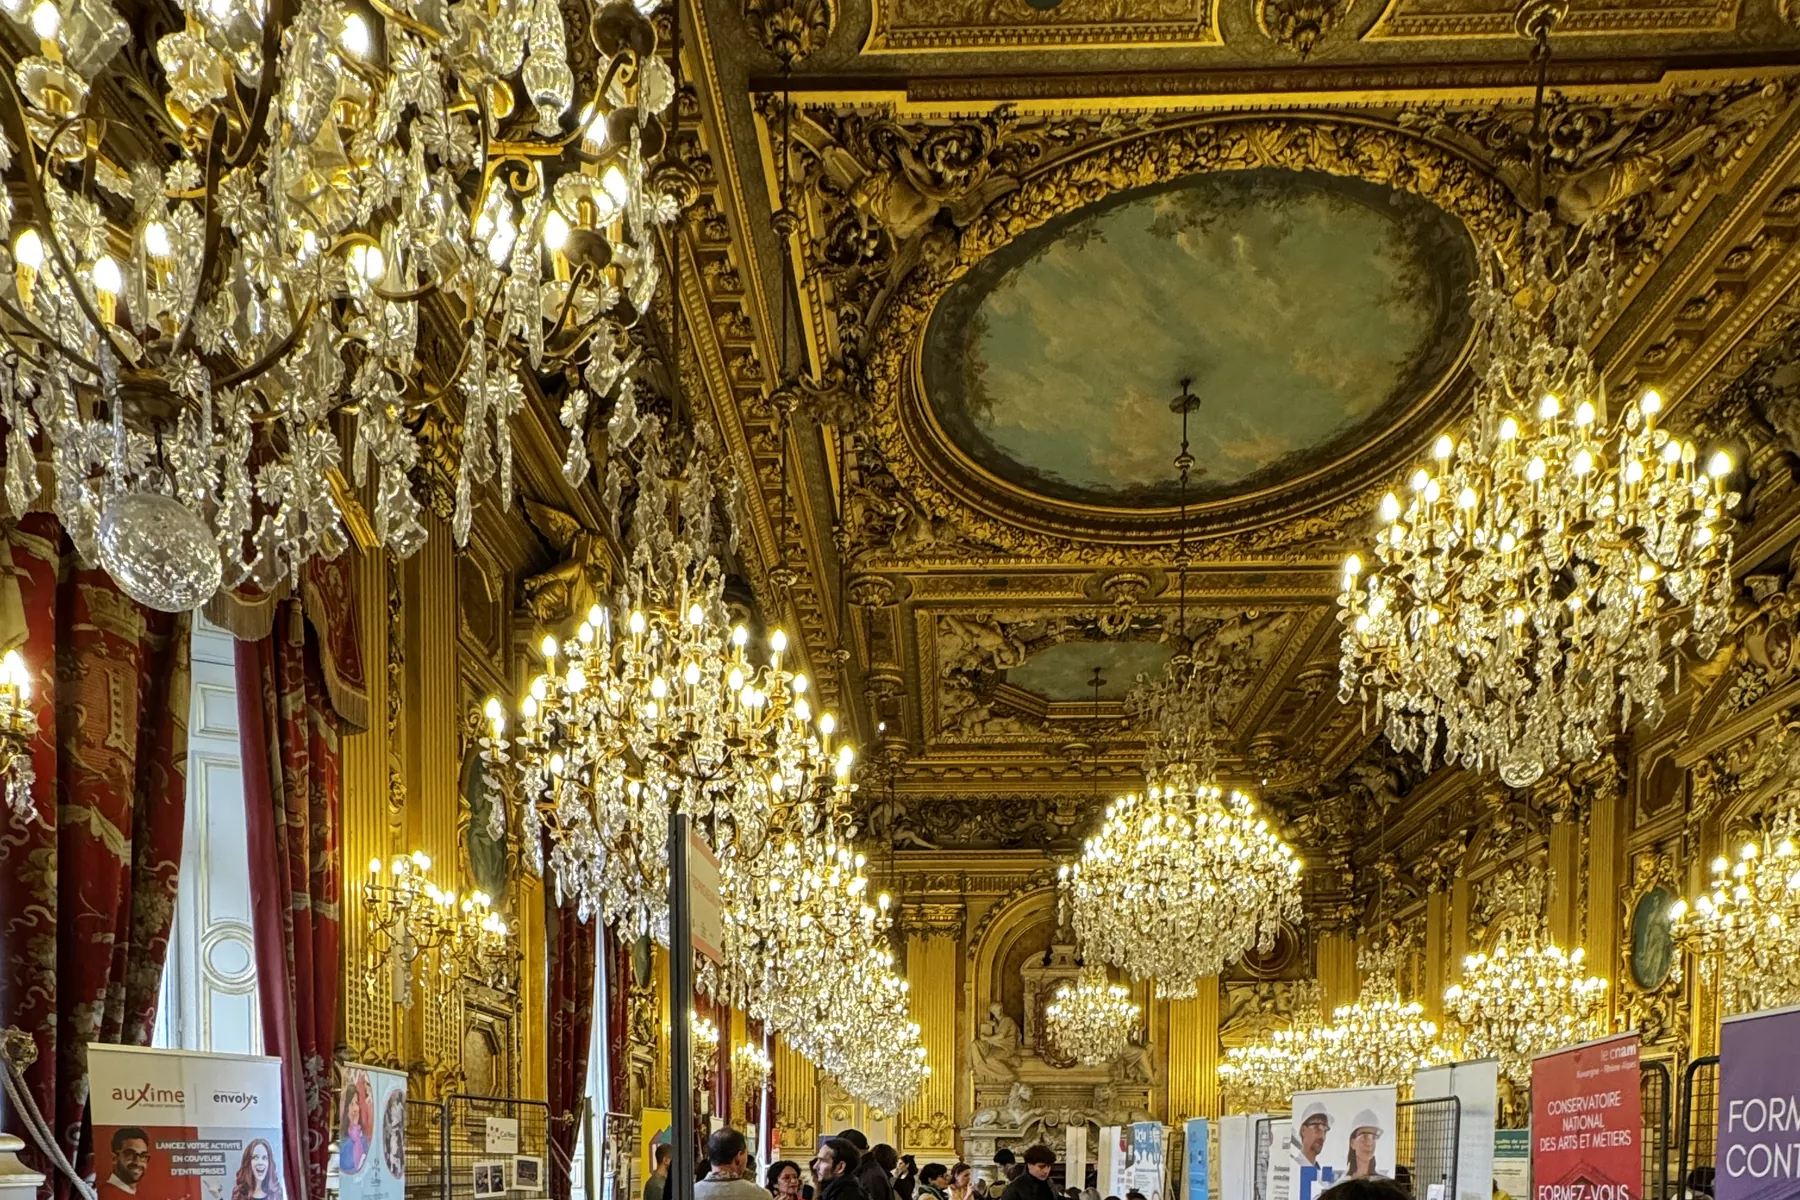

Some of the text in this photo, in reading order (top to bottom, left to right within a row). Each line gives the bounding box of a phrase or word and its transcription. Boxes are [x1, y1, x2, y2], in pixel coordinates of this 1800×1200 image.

[1609, 1044, 1637, 1059] cnam
[112, 1082, 185, 1110] auxime
[213, 1092, 259, 1111] envolys
[1547, 1090, 1622, 1116] CONSERVATOIRE
[1562, 1112, 1605, 1132] NATIONAL
[156, 1141, 186, 1150] LANCEZ
[186, 1141, 209, 1150] VOTRE
[1540, 1128, 1632, 1152] DES ARTS ET MÉTIERS
[172, 1154, 222, 1163] EN COUVEUSE
[171, 1167, 226, 1177] D'ENTREPRISES
